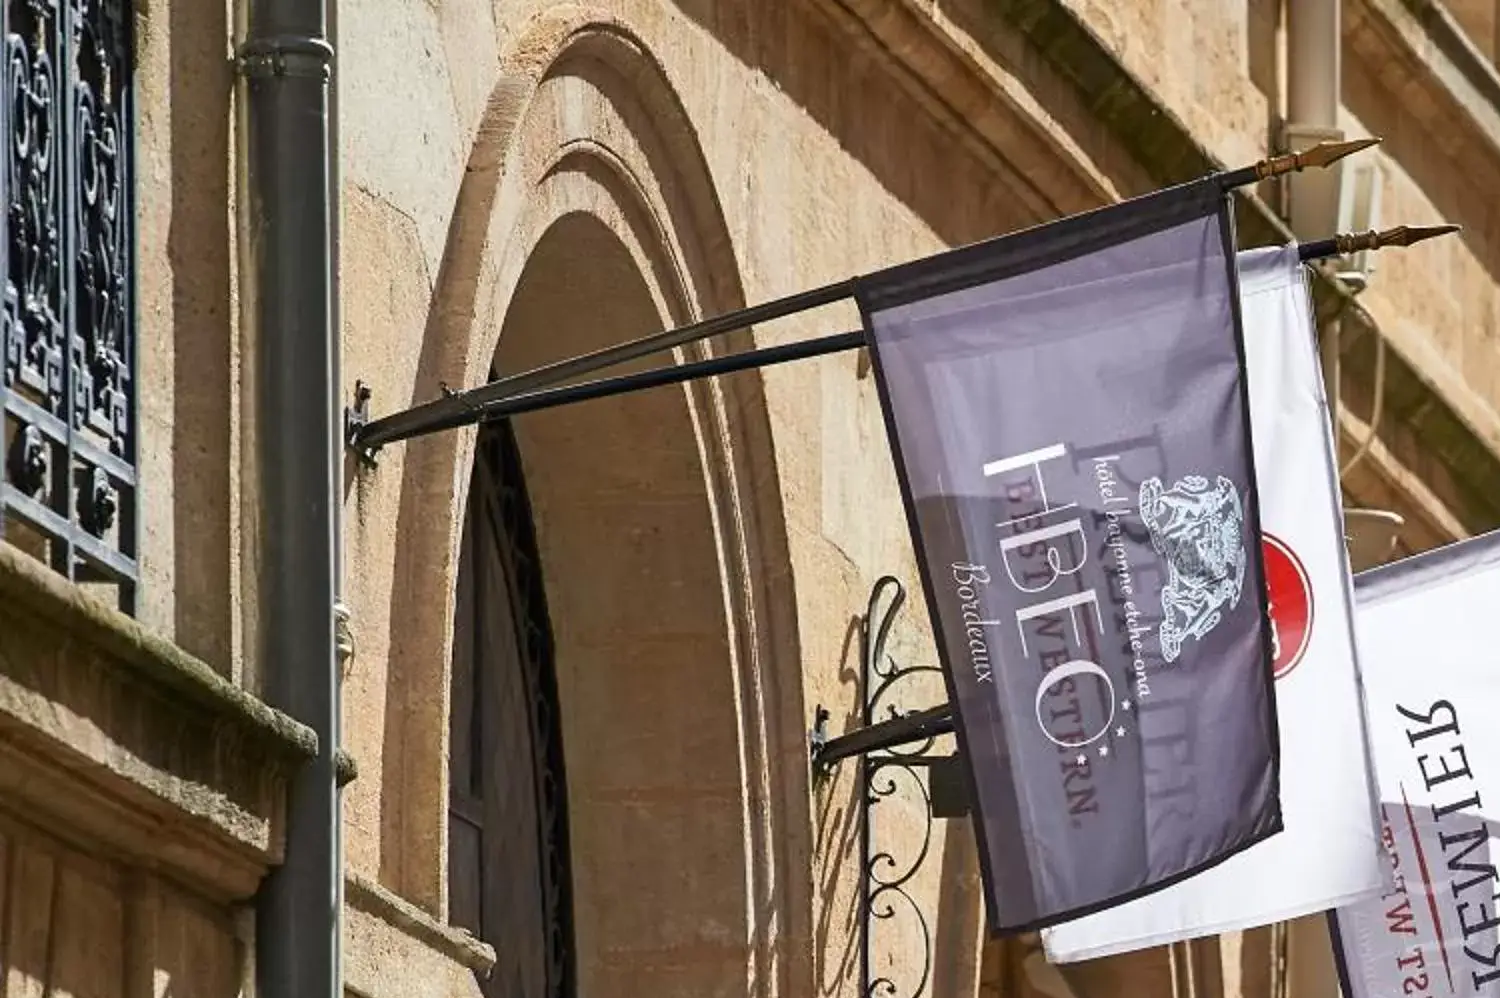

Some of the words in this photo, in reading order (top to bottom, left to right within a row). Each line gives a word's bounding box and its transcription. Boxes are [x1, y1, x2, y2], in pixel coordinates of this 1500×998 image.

[1093, 455, 1129, 505] hôtel
[1105, 509, 1135, 596] bayonne
[950, 561, 1001, 685] Bordeaux
[1121, 600, 1154, 699] etche-ona
